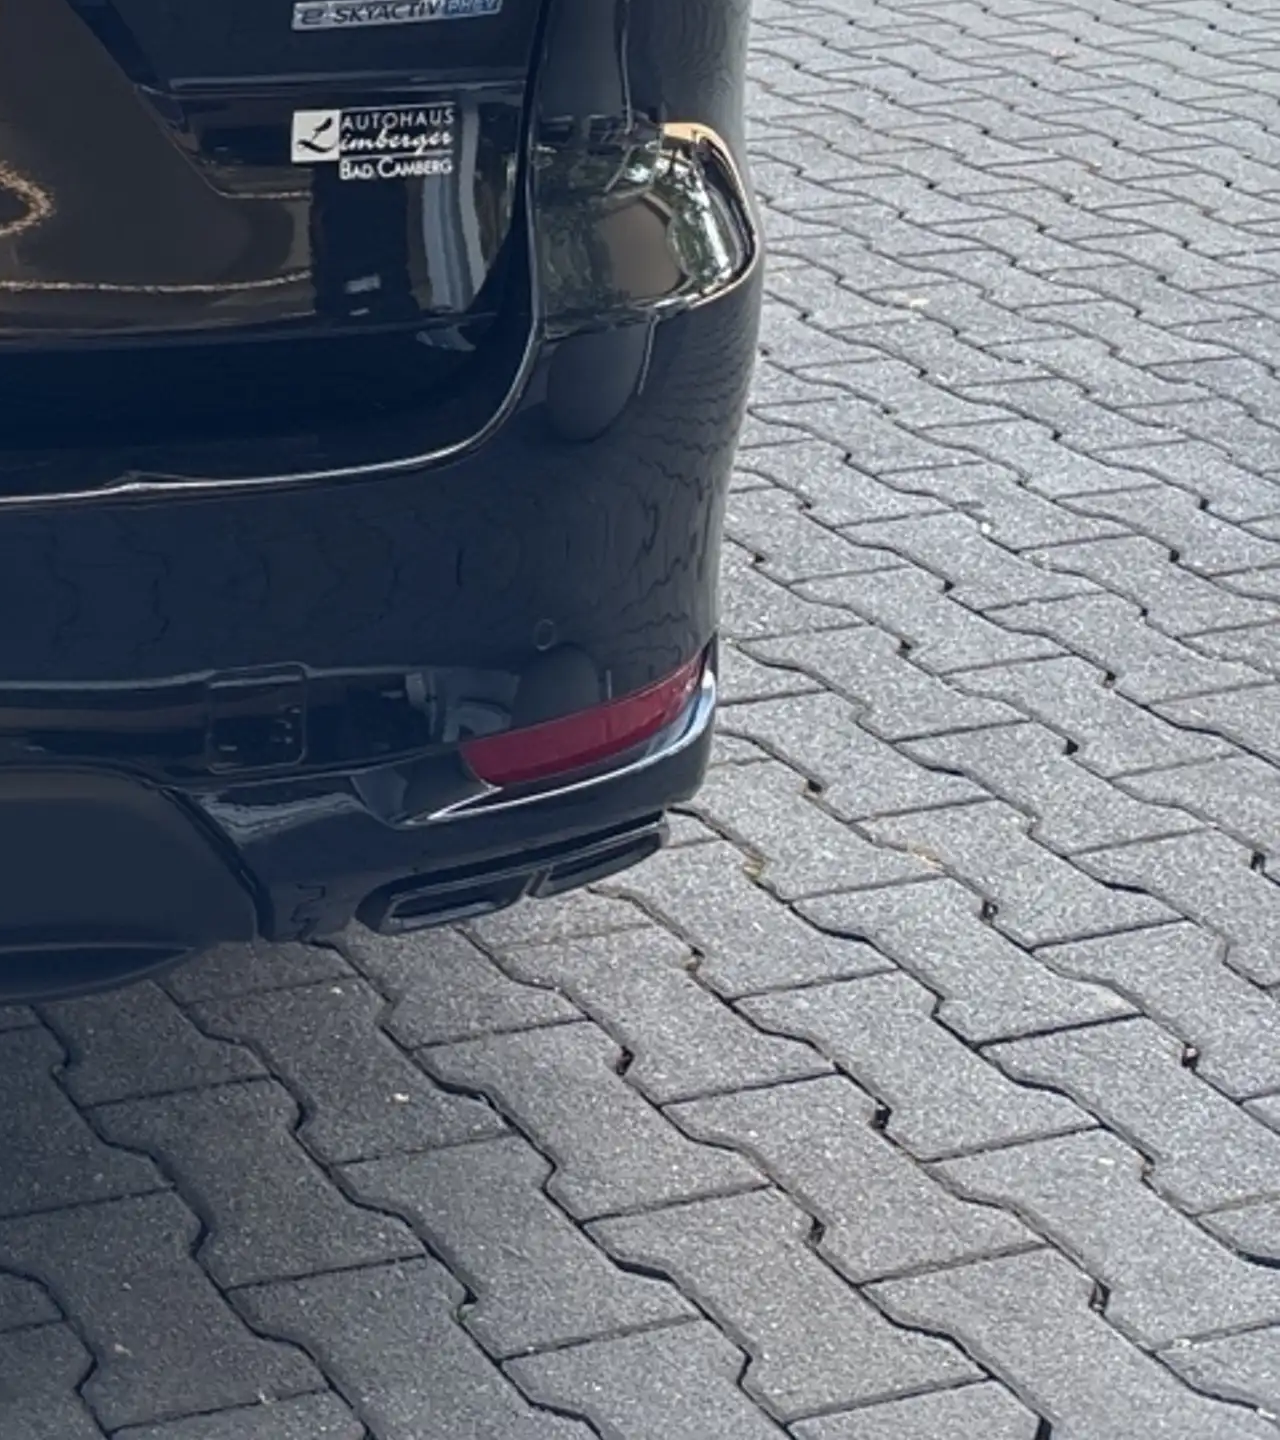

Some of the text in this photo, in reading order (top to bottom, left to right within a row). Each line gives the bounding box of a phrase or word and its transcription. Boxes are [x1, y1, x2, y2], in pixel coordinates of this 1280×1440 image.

[340, 108, 455, 131] AUTOHAUS
[297, 116, 454, 156] Limberger
[340, 160, 374, 181] BAD
